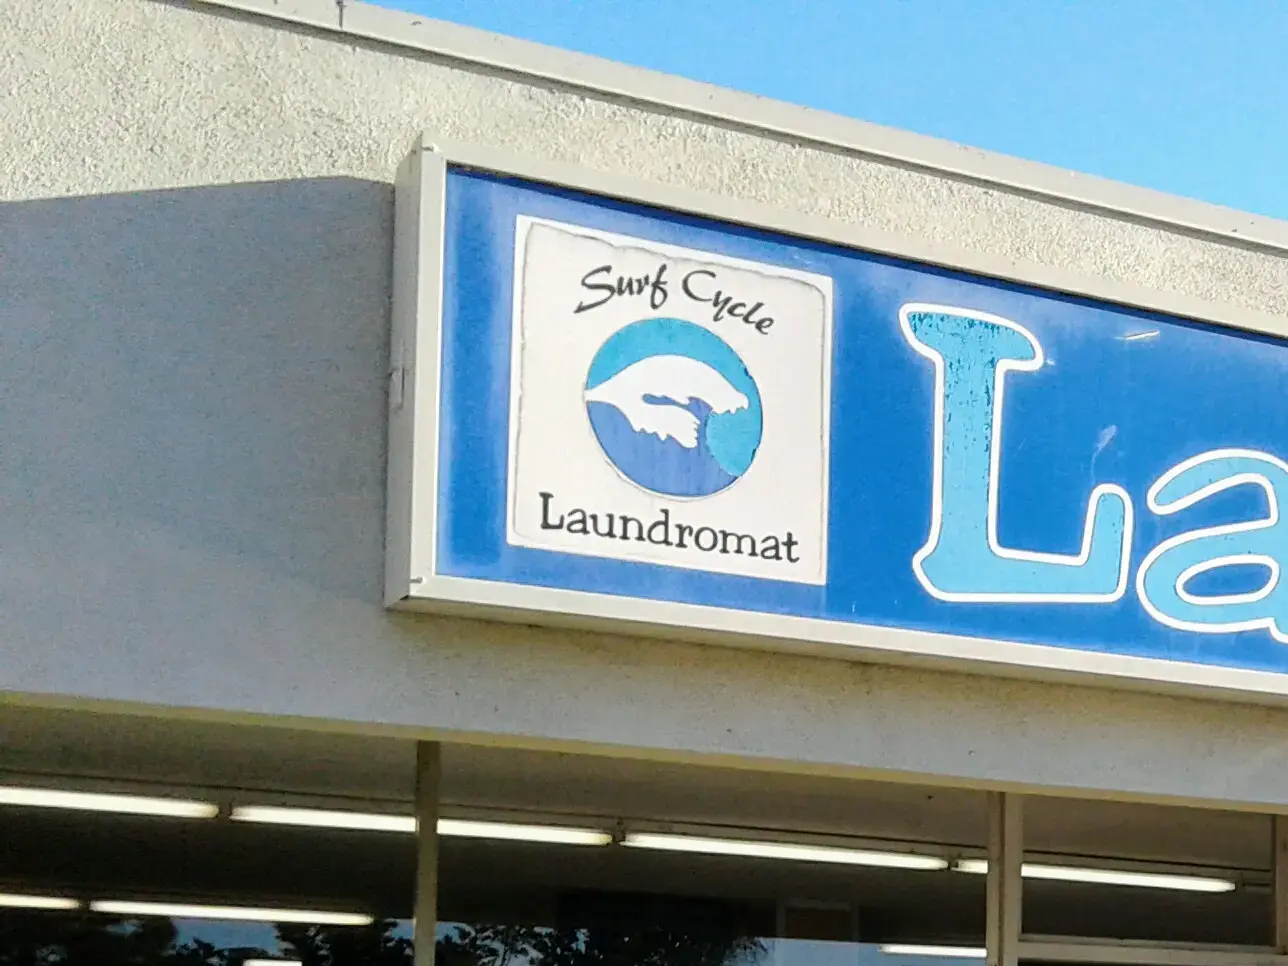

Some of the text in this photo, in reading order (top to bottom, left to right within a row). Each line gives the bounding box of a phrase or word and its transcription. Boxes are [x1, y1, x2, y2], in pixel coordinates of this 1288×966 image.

[574, 264, 775, 336] Surf Cycle
[539, 492, 801, 564] Laundromat
